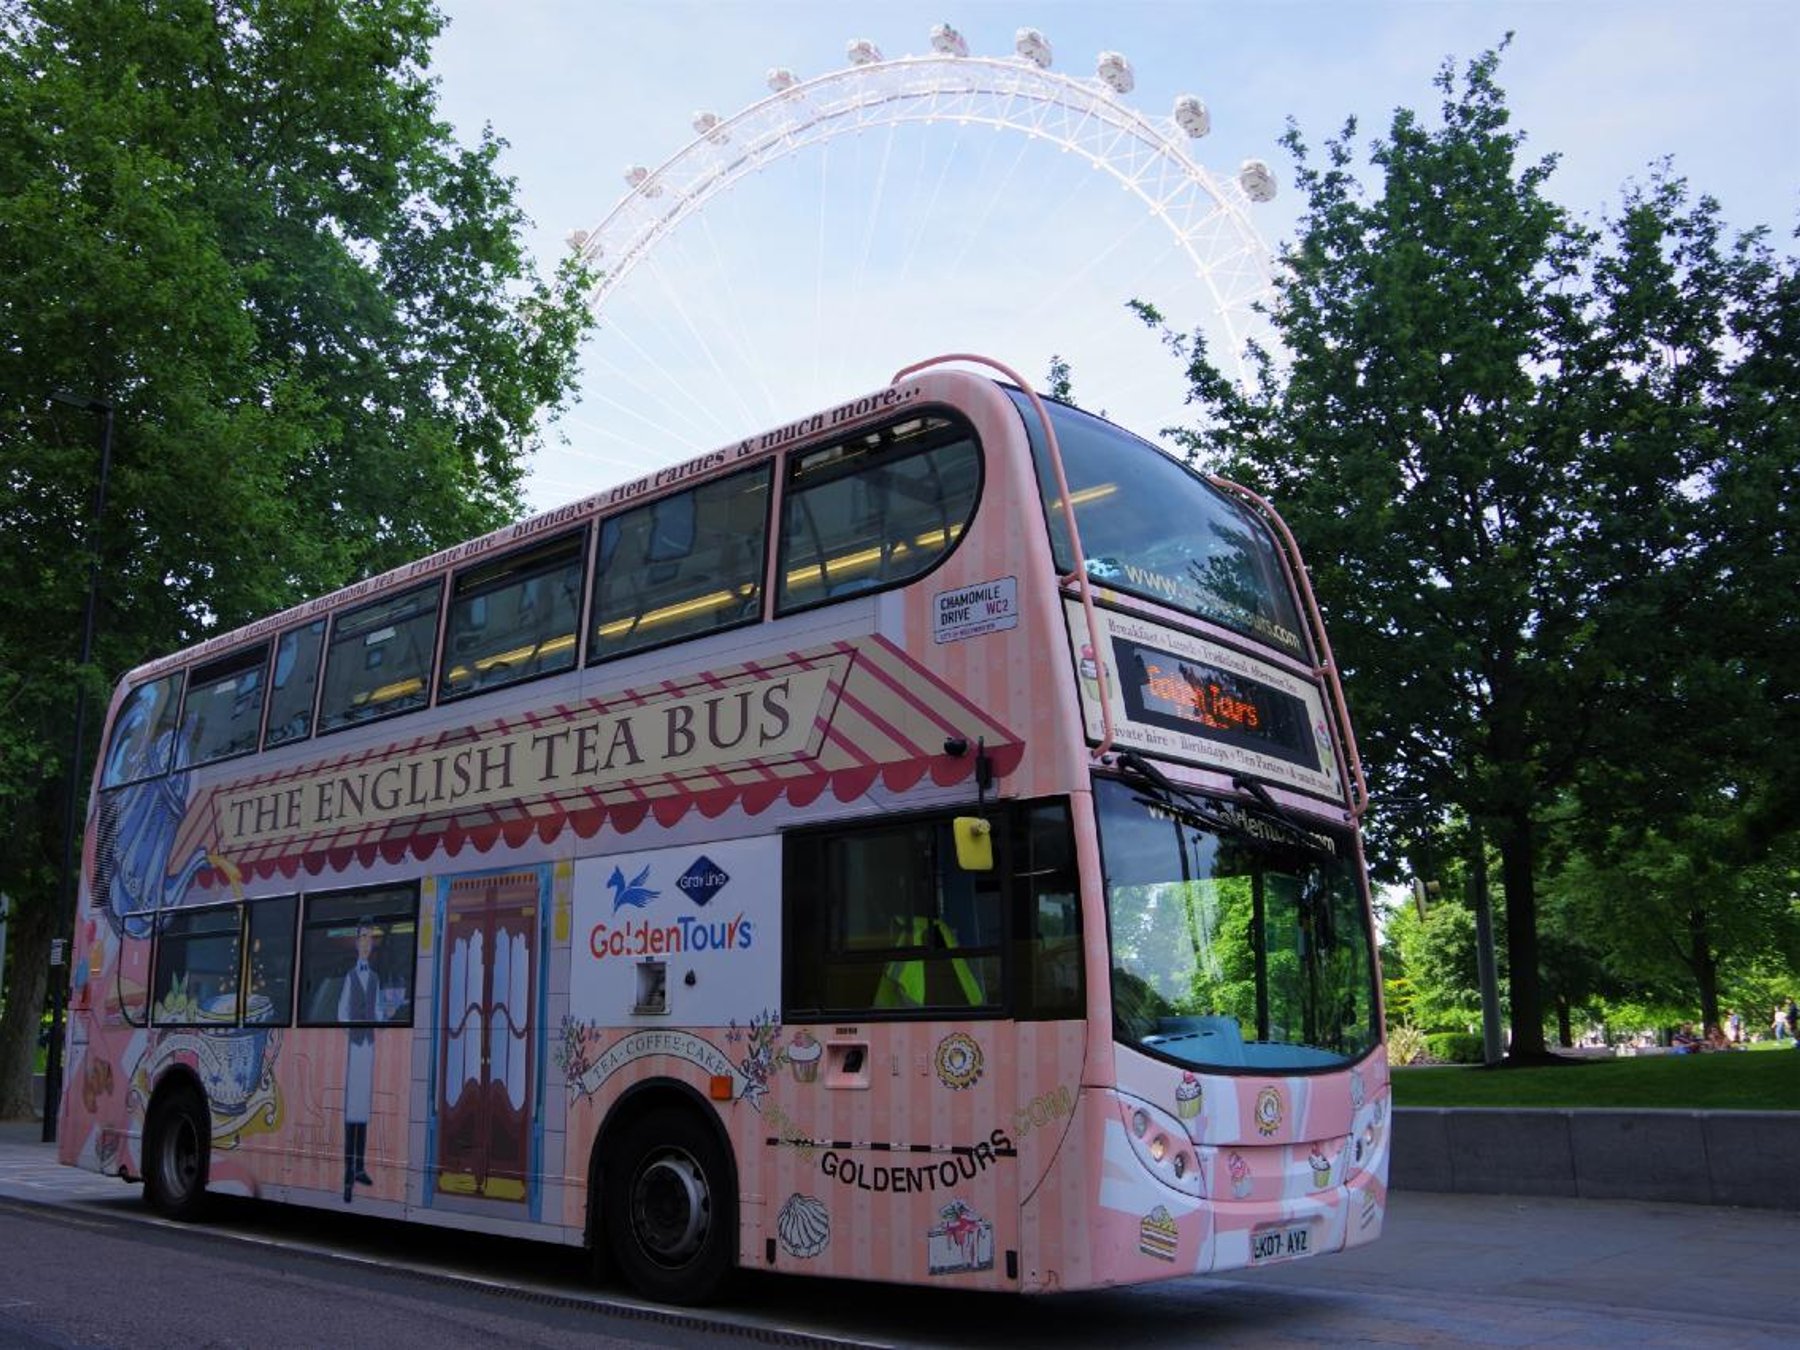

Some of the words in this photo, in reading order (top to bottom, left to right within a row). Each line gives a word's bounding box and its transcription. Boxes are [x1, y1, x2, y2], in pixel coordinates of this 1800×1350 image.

[737, 438, 755, 458] &
[940, 585, 1001, 611] CHAMOMILE
[941, 607, 970, 626] DRIVE
[986, 598, 1009, 615] WC2
[1100, 720, 1143, 742] ivate
[229, 788, 302, 838] THE
[313, 741, 515, 824] ENGLISH
[531, 716, 644, 782] TEA
[661, 678, 791, 759] BUS
[593, 1053, 619, 1075] TEA
[626, 1035, 680, 1052] COFFEE
[821, 1128, 1012, 1194] GOLDENTOURS
[1287, 1230, 1308, 1254] AYZ
